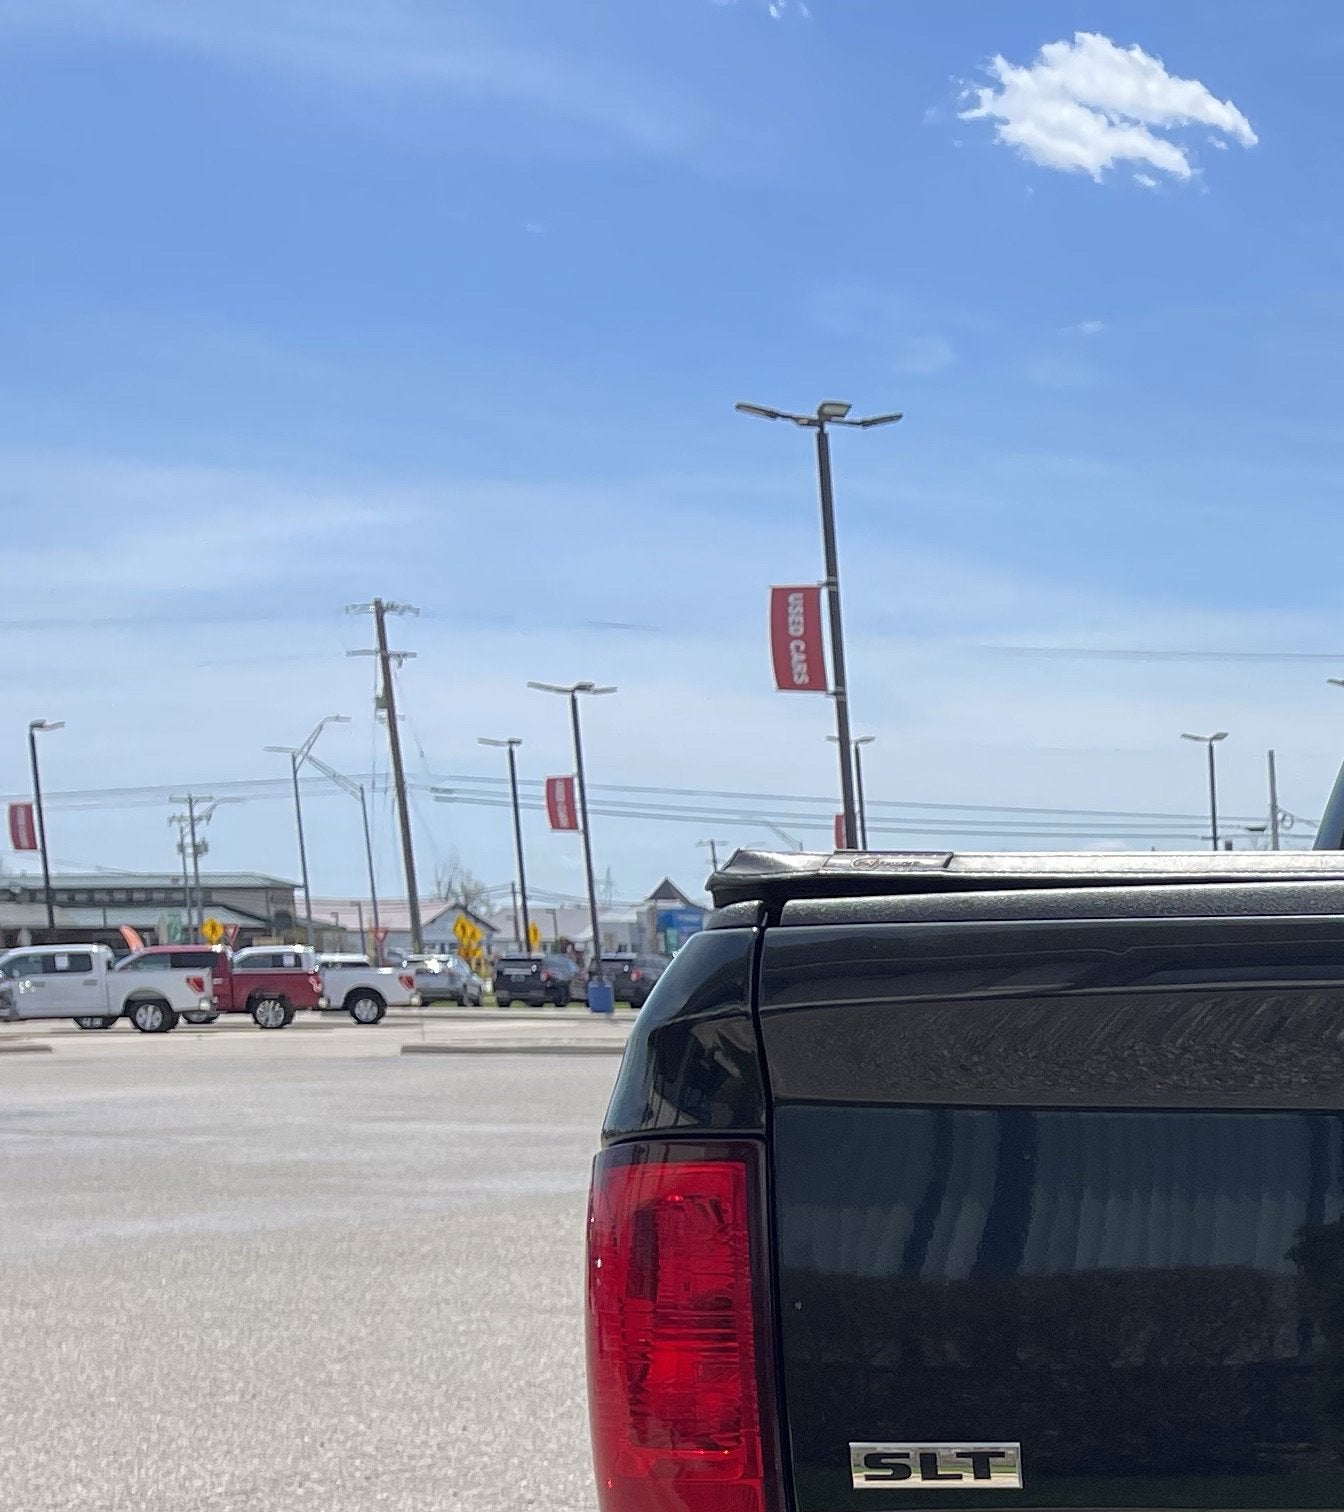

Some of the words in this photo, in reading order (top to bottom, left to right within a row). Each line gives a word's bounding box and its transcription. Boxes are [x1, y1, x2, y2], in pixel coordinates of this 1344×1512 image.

[787, 592, 804, 638] USED
[789, 639, 810, 685] CARS
[861, 1450, 1008, 1483] SLT
